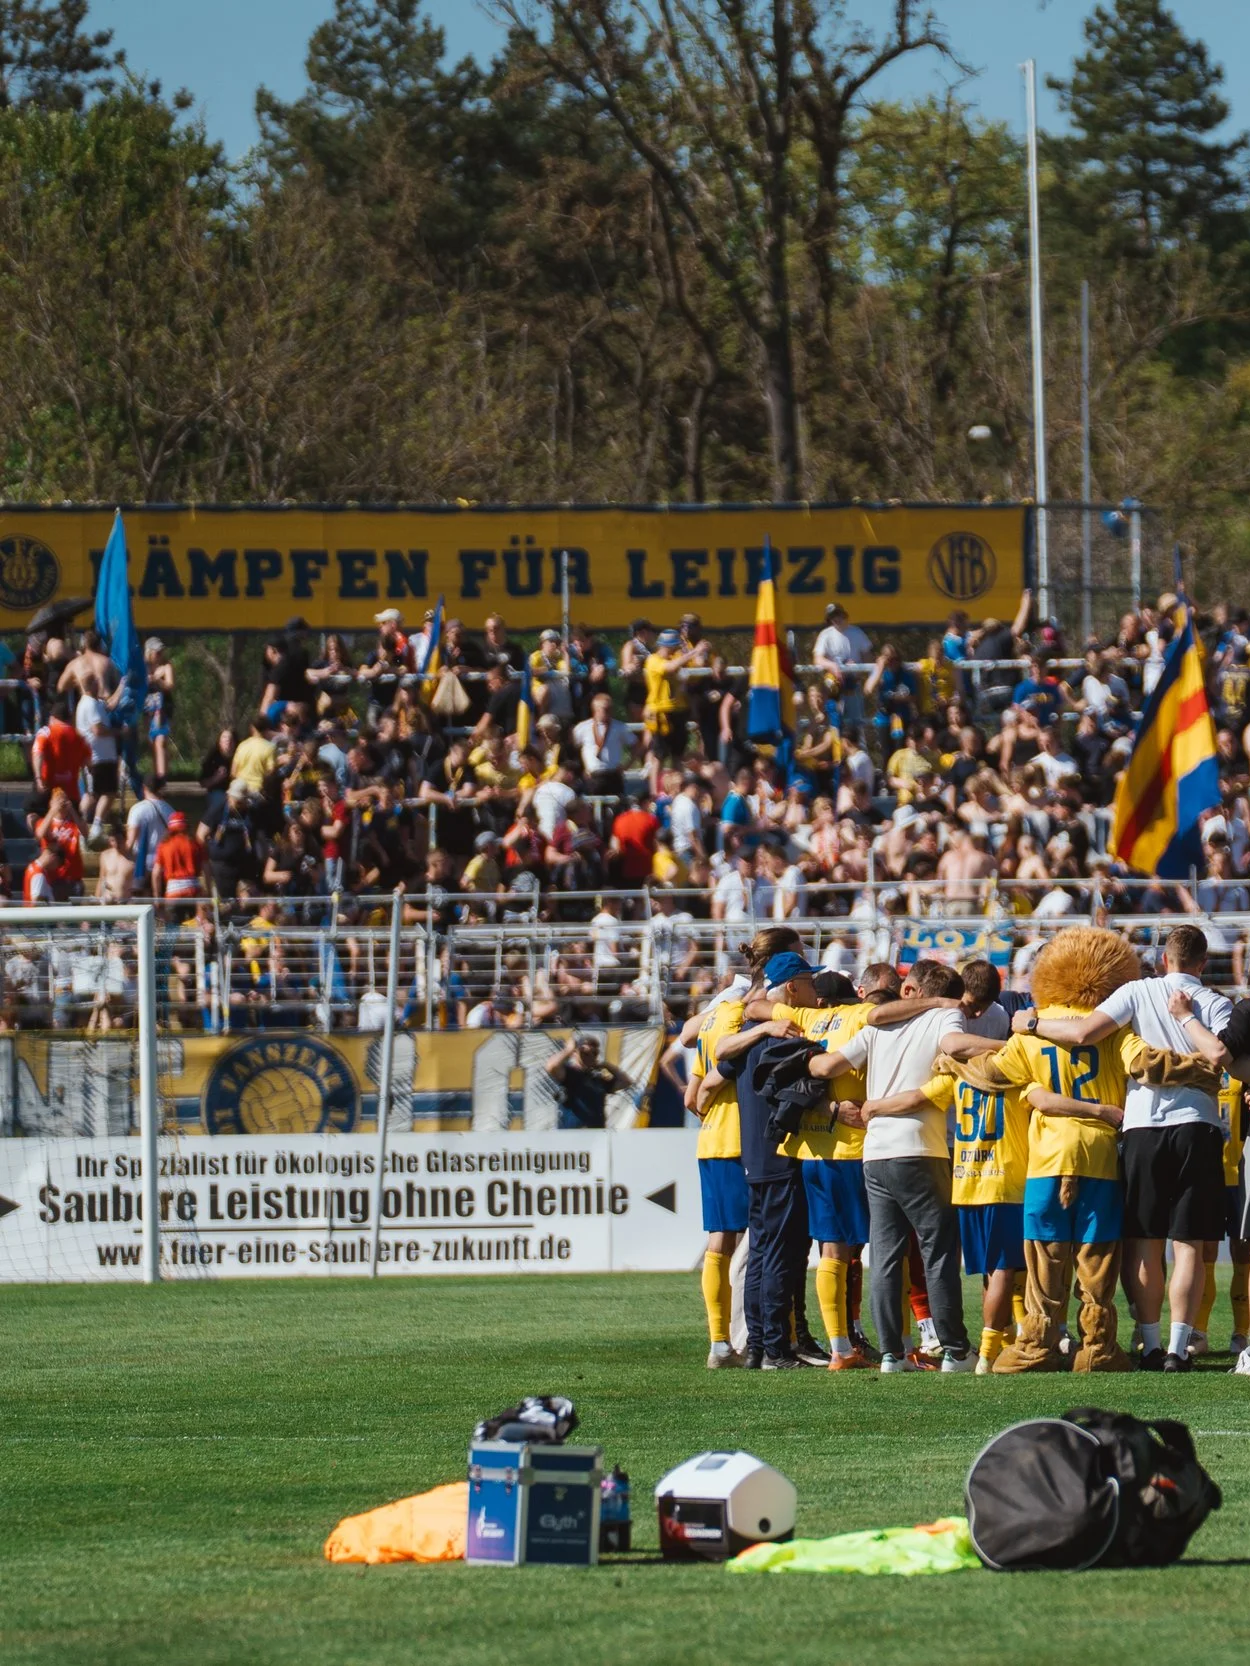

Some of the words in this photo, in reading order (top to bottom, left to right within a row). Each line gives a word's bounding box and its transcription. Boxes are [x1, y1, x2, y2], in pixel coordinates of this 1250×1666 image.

[89, 535, 430, 598] ÄMPFEN
[459, 535, 592, 598] FÜR
[626, 545, 901, 598] LEIPZIG
[1041, 1045, 1100, 1104] 12
[956, 1081, 1005, 1141] 30
[76, 1154, 108, 1178] Ihr
[115, 1152, 229, 1179] Spzialist
[235, 1151, 268, 1175] für
[426, 1148, 591, 1174] Glasreinigung
[39, 1183, 198, 1223] Saubre
[208, 1182, 370, 1224] Leistung
[382, 1180, 476, 1218] ohne
[487, 1178, 630, 1216] Chemie
[97, 1233, 571, 1266] ww.fuer-eine-saubere-zukunft.de
